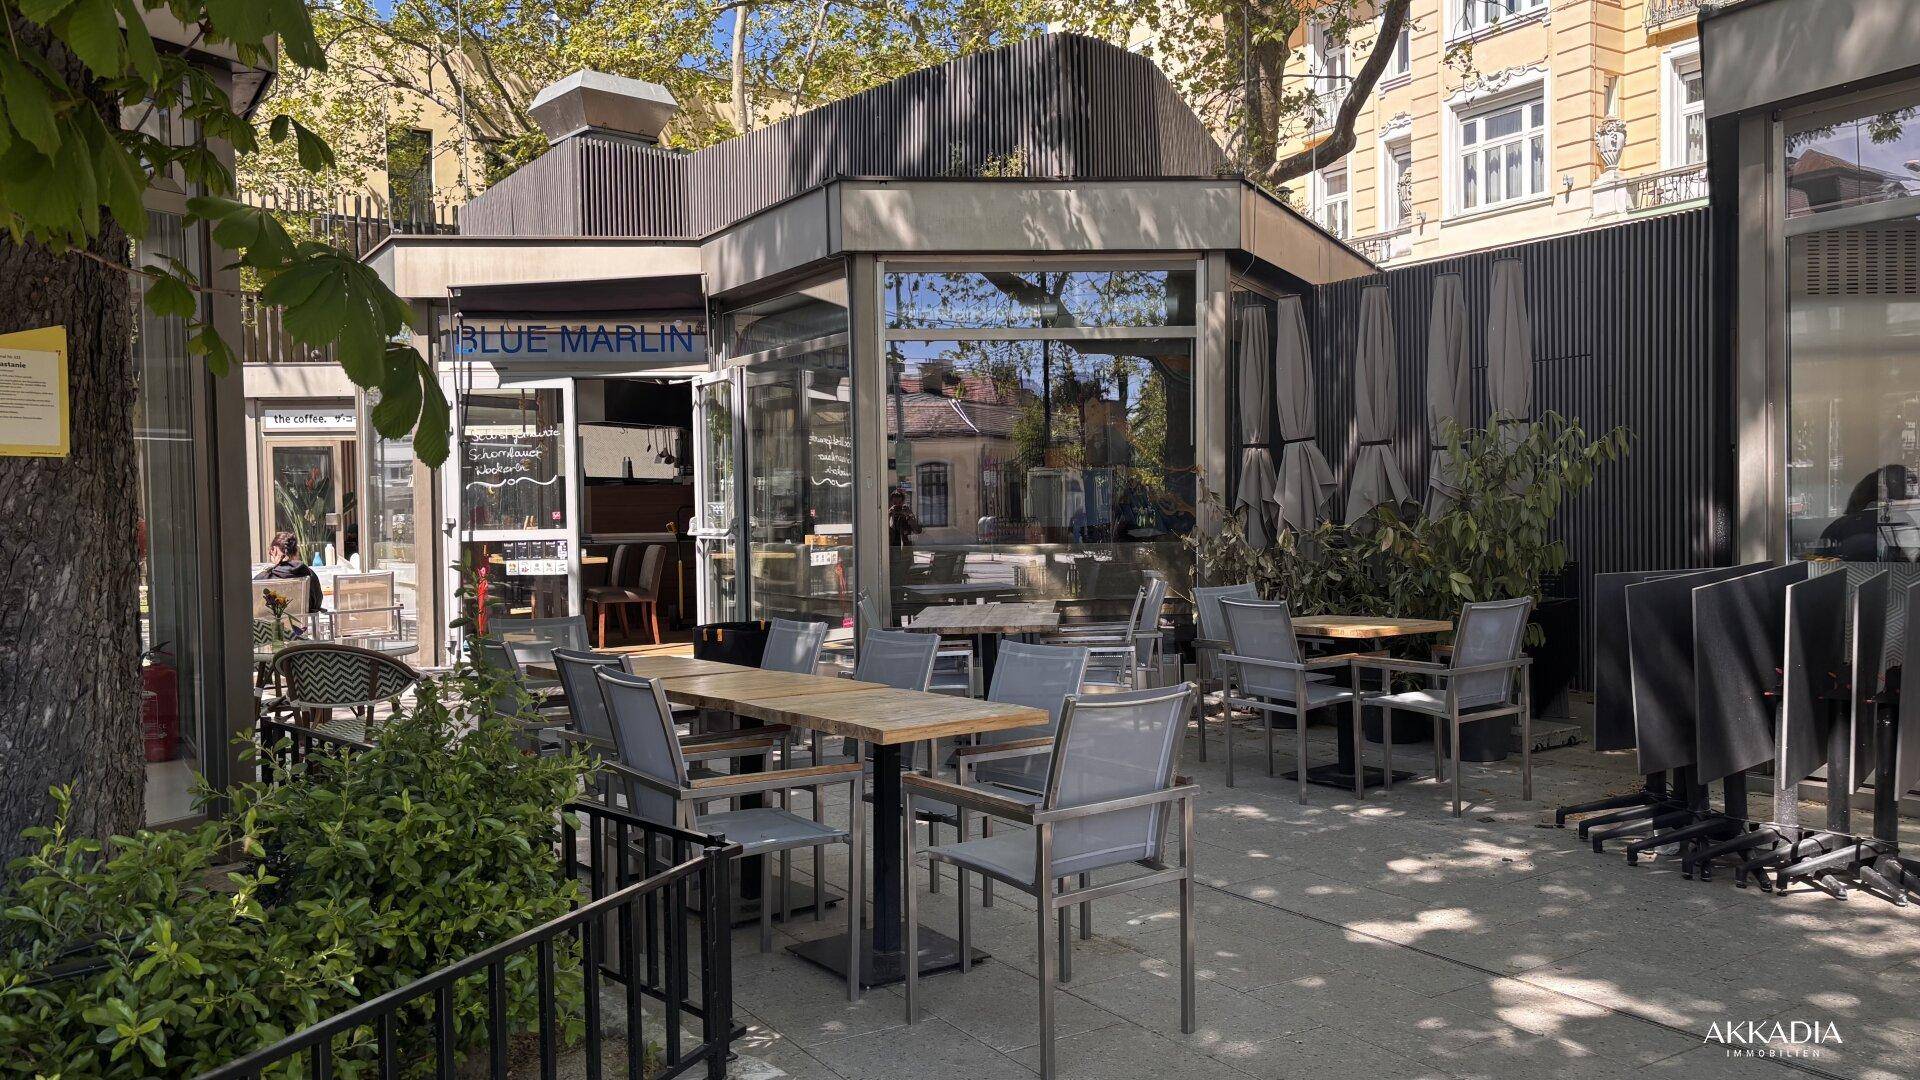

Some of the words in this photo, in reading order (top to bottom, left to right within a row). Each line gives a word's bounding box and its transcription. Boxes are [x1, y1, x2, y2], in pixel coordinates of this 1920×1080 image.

[455, 325, 547, 354] BLUE
[560, 324, 693, 353] MARLIN
[274, 414, 291, 424] the
[293, 414, 327, 424] coffee.
